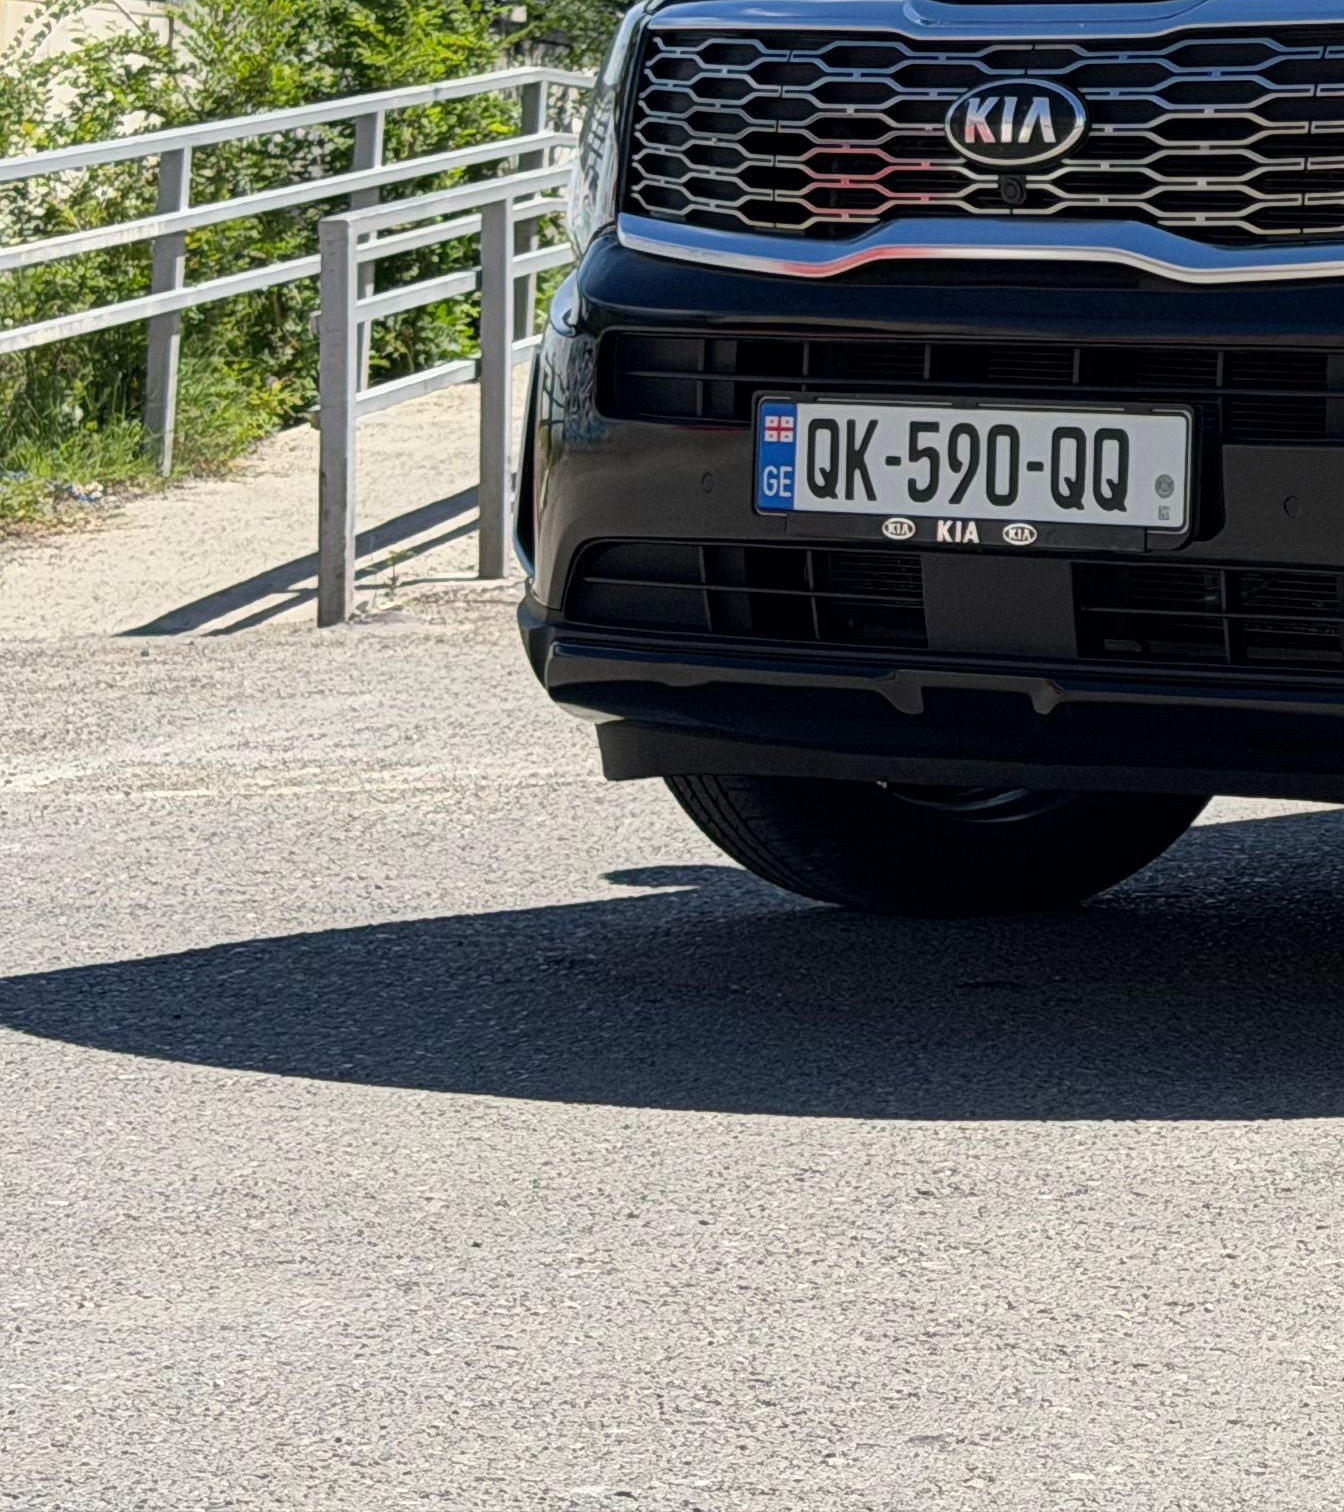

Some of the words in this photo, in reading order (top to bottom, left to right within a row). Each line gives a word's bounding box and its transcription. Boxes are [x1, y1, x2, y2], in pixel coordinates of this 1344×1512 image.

[964, 96, 1057, 145] KIA
[763, 465, 793, 498] GE
[806, 418, 1130, 513] QK-590-QQ
[888, 522, 911, 535] KIA
[937, 519, 980, 544] KIA
[1008, 528, 1032, 541] KIA
